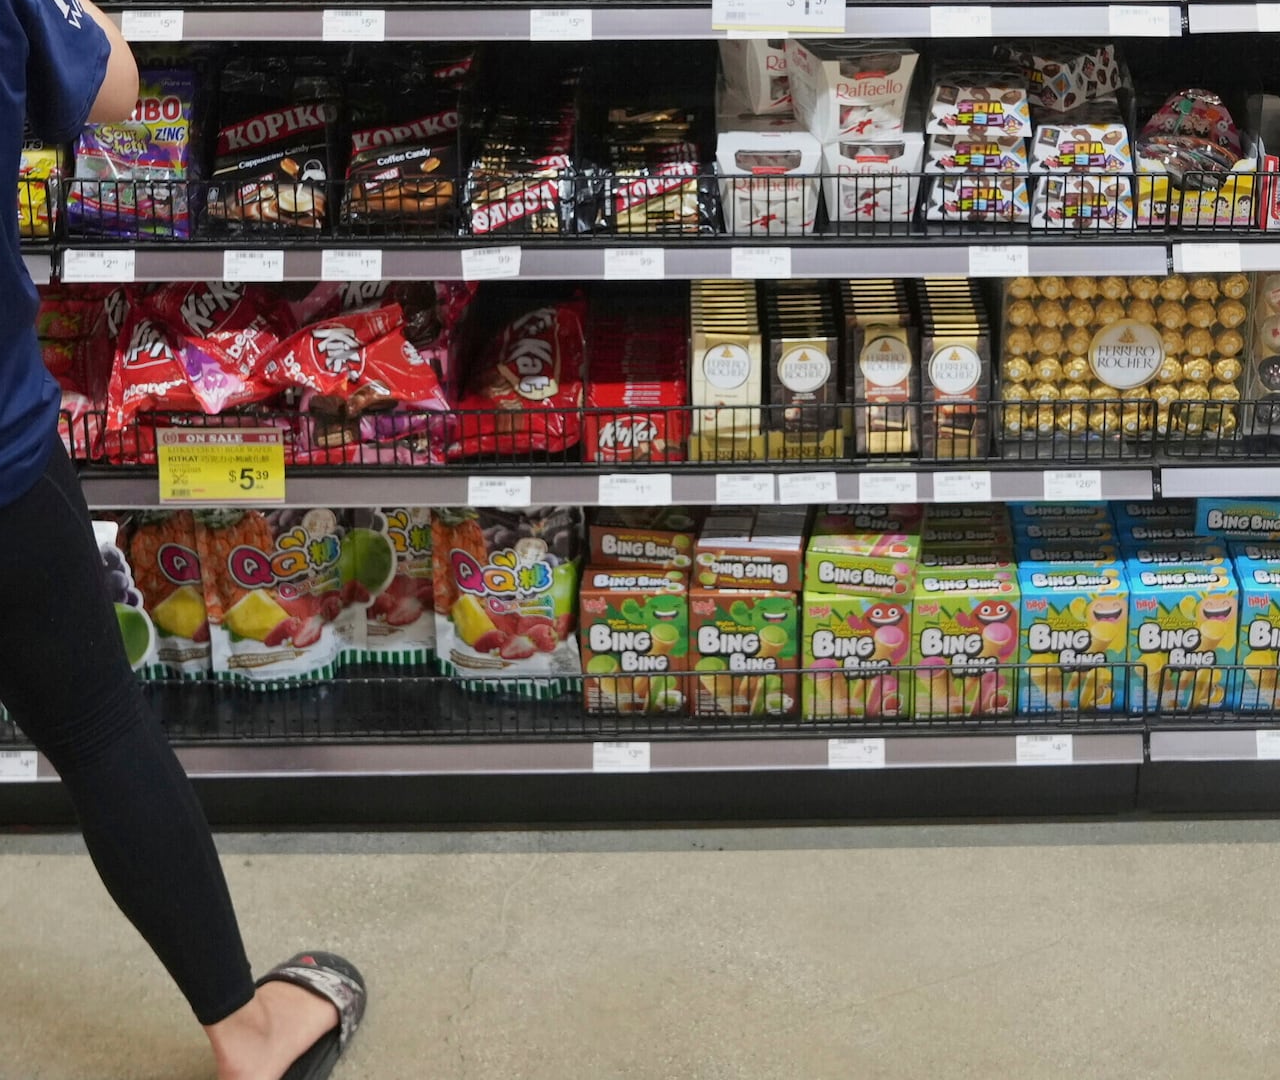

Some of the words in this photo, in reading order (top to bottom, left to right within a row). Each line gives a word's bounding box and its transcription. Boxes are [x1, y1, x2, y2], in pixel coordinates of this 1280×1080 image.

[836, 80, 903, 99] Raffaello
[226, 104, 335, 148] KOPIKO
[377, 151, 406, 165] Coffee
[407, 148, 431, 162] Candy
[1096, 356, 1156, 371] ROCHER
[186, 434, 205, 443] ON
[208, 434, 244, 443] SALE
[255, 471, 269, 480] 39
[590, 623, 654, 654] BING
[621, 650, 669, 672] BING
